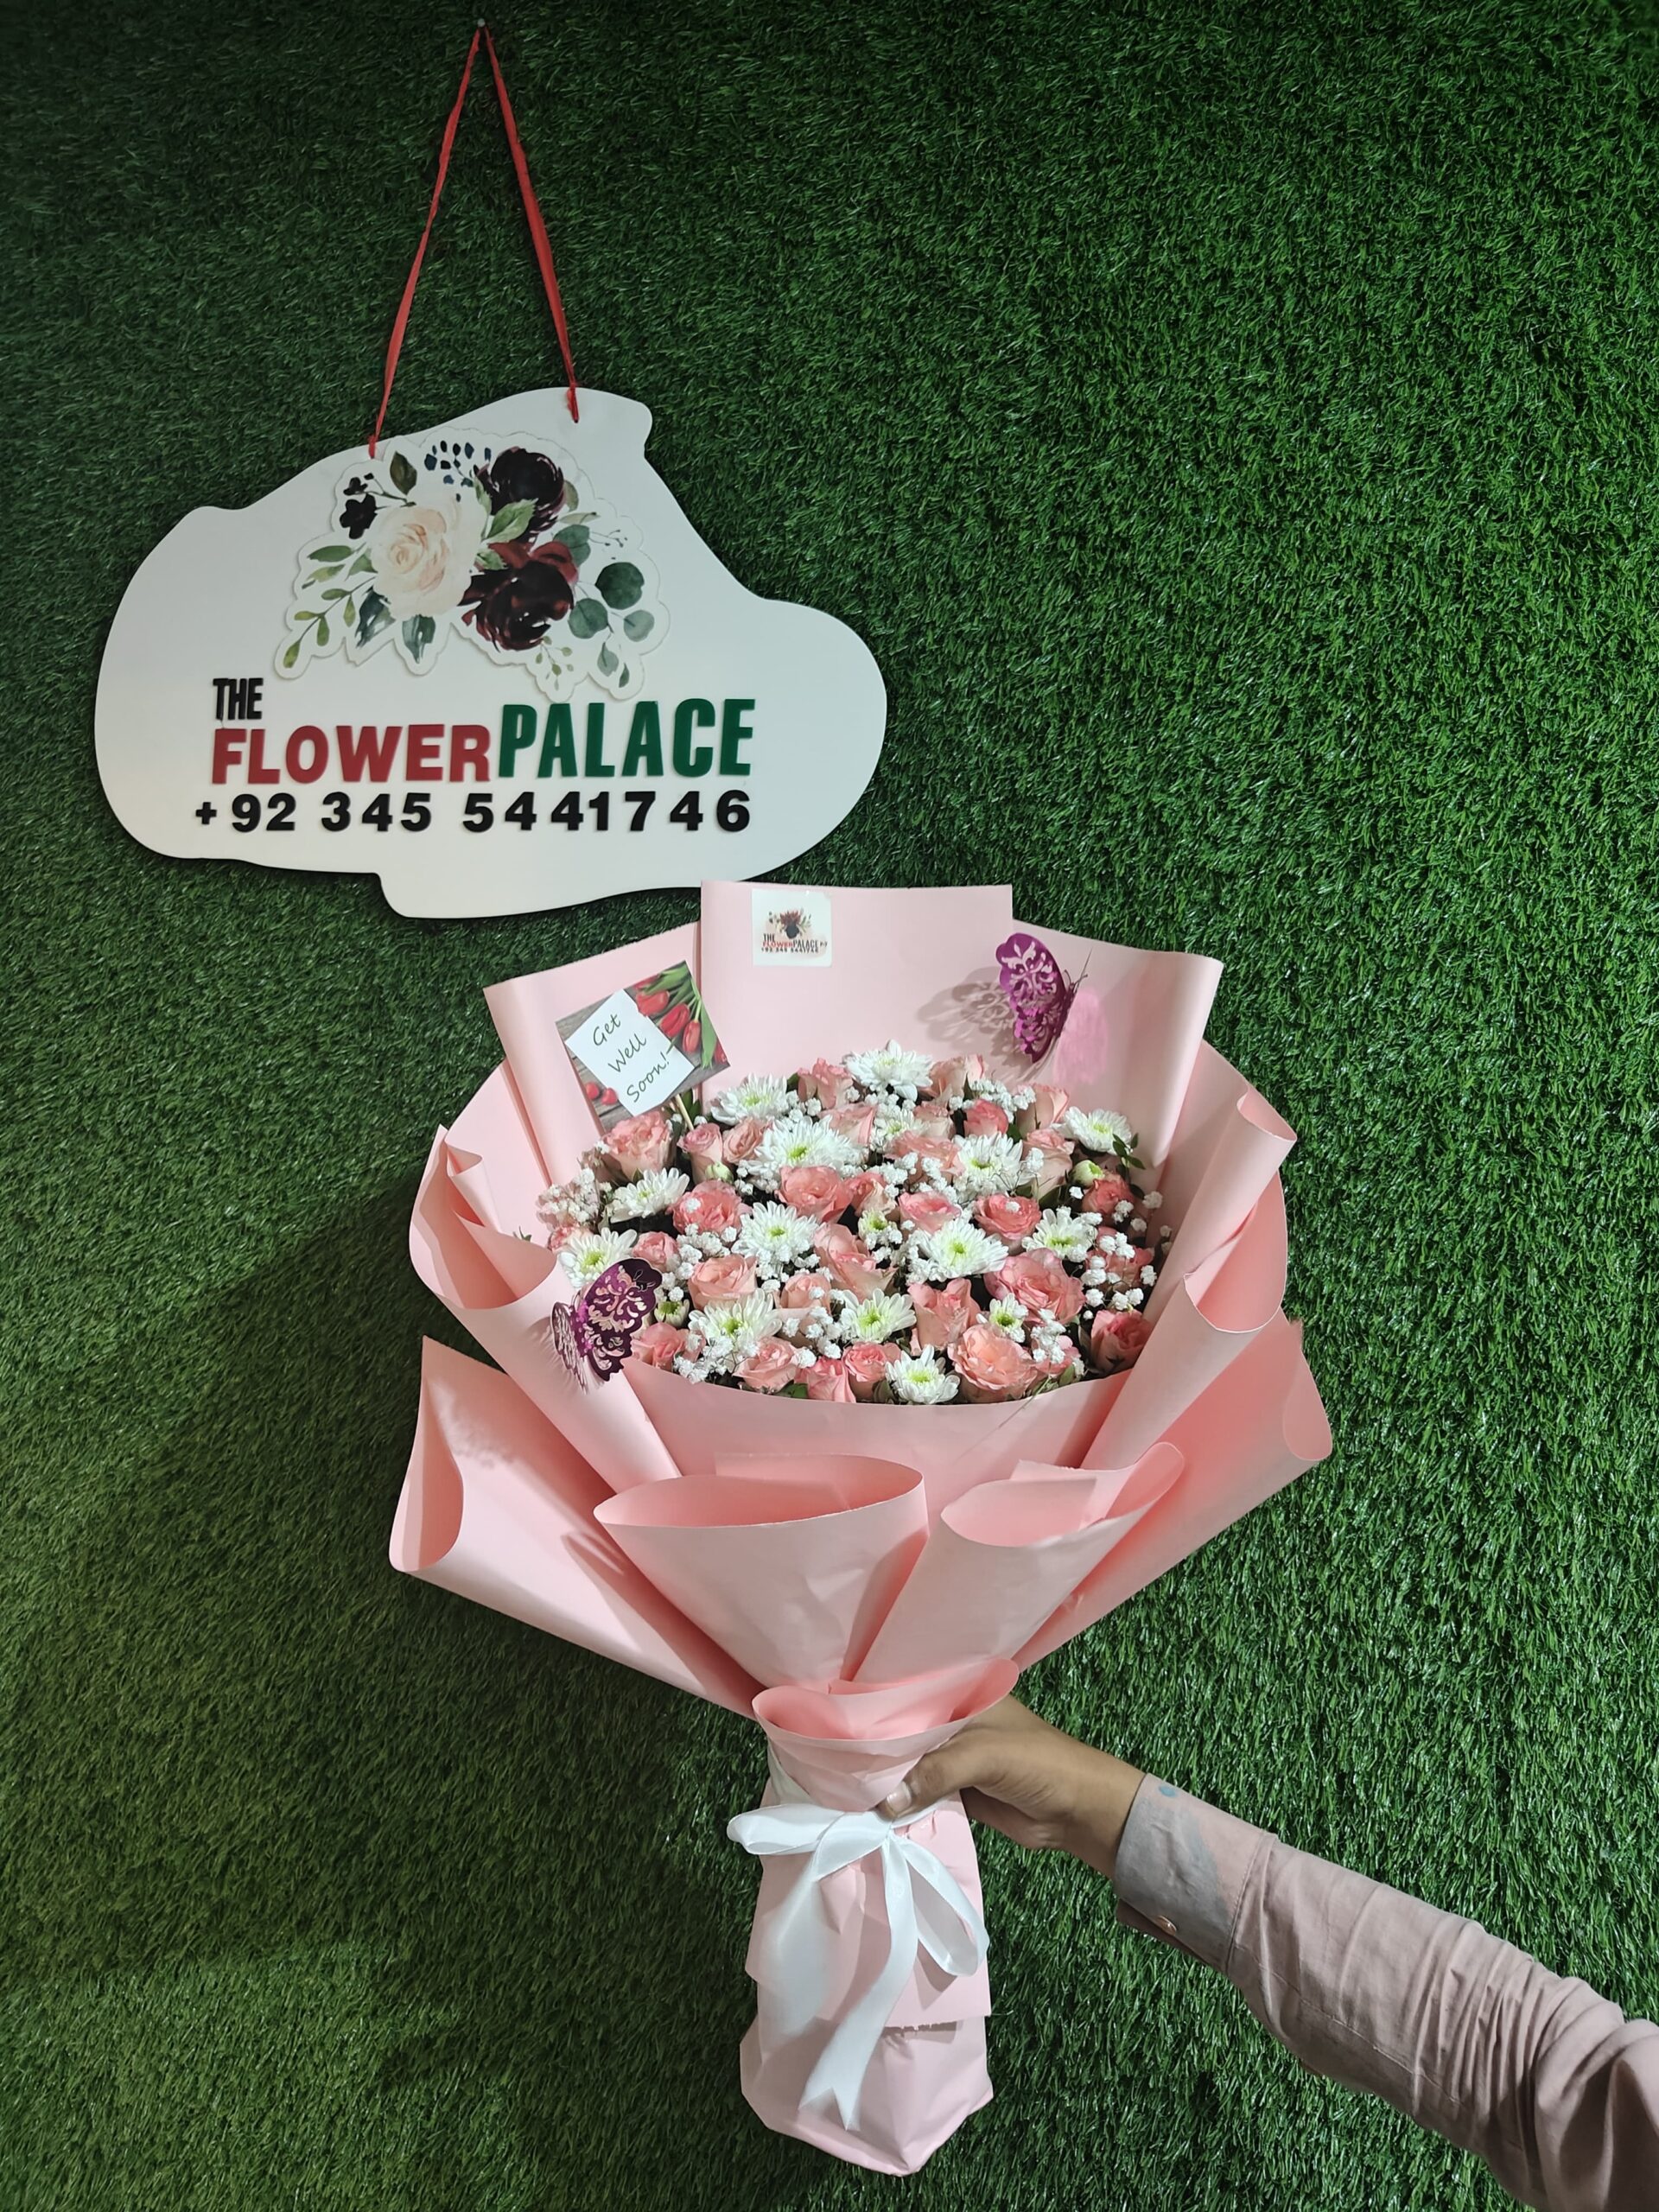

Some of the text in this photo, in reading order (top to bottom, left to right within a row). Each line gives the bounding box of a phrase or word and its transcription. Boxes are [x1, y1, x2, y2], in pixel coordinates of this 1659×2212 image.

[213, 677, 263, 720] THE
[212, 698, 756, 784] FLOWER PALACE
[195, 790, 750, 832] +92 345 5441746
[763, 933, 775, 942] THE
[593, 1014, 621, 1046] Get
[608, 1033, 646, 1072] Well
[626, 1052, 670, 1103] Soon!
